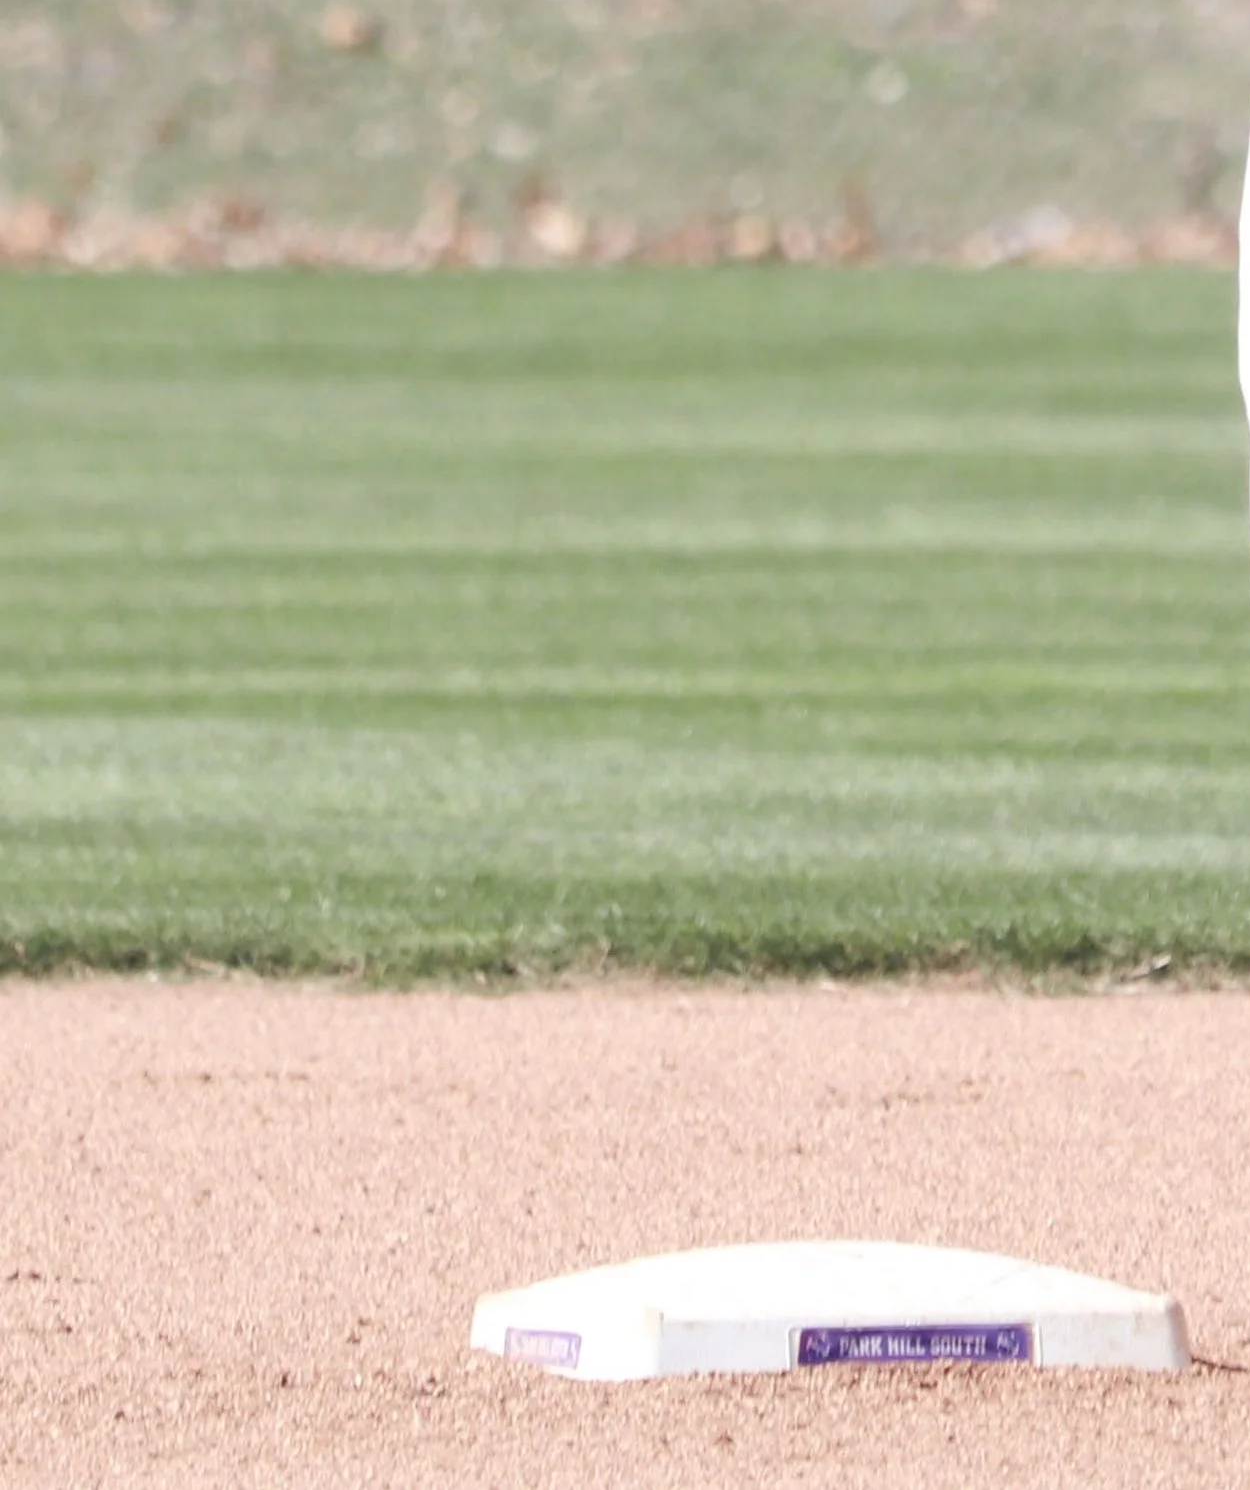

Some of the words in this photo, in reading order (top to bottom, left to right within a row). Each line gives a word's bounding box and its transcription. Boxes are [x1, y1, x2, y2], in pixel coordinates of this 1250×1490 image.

[840, 1335, 883, 1358] PARK
[887, 1335, 926, 1357] HILL
[930, 1333, 987, 1357] SOUTH
